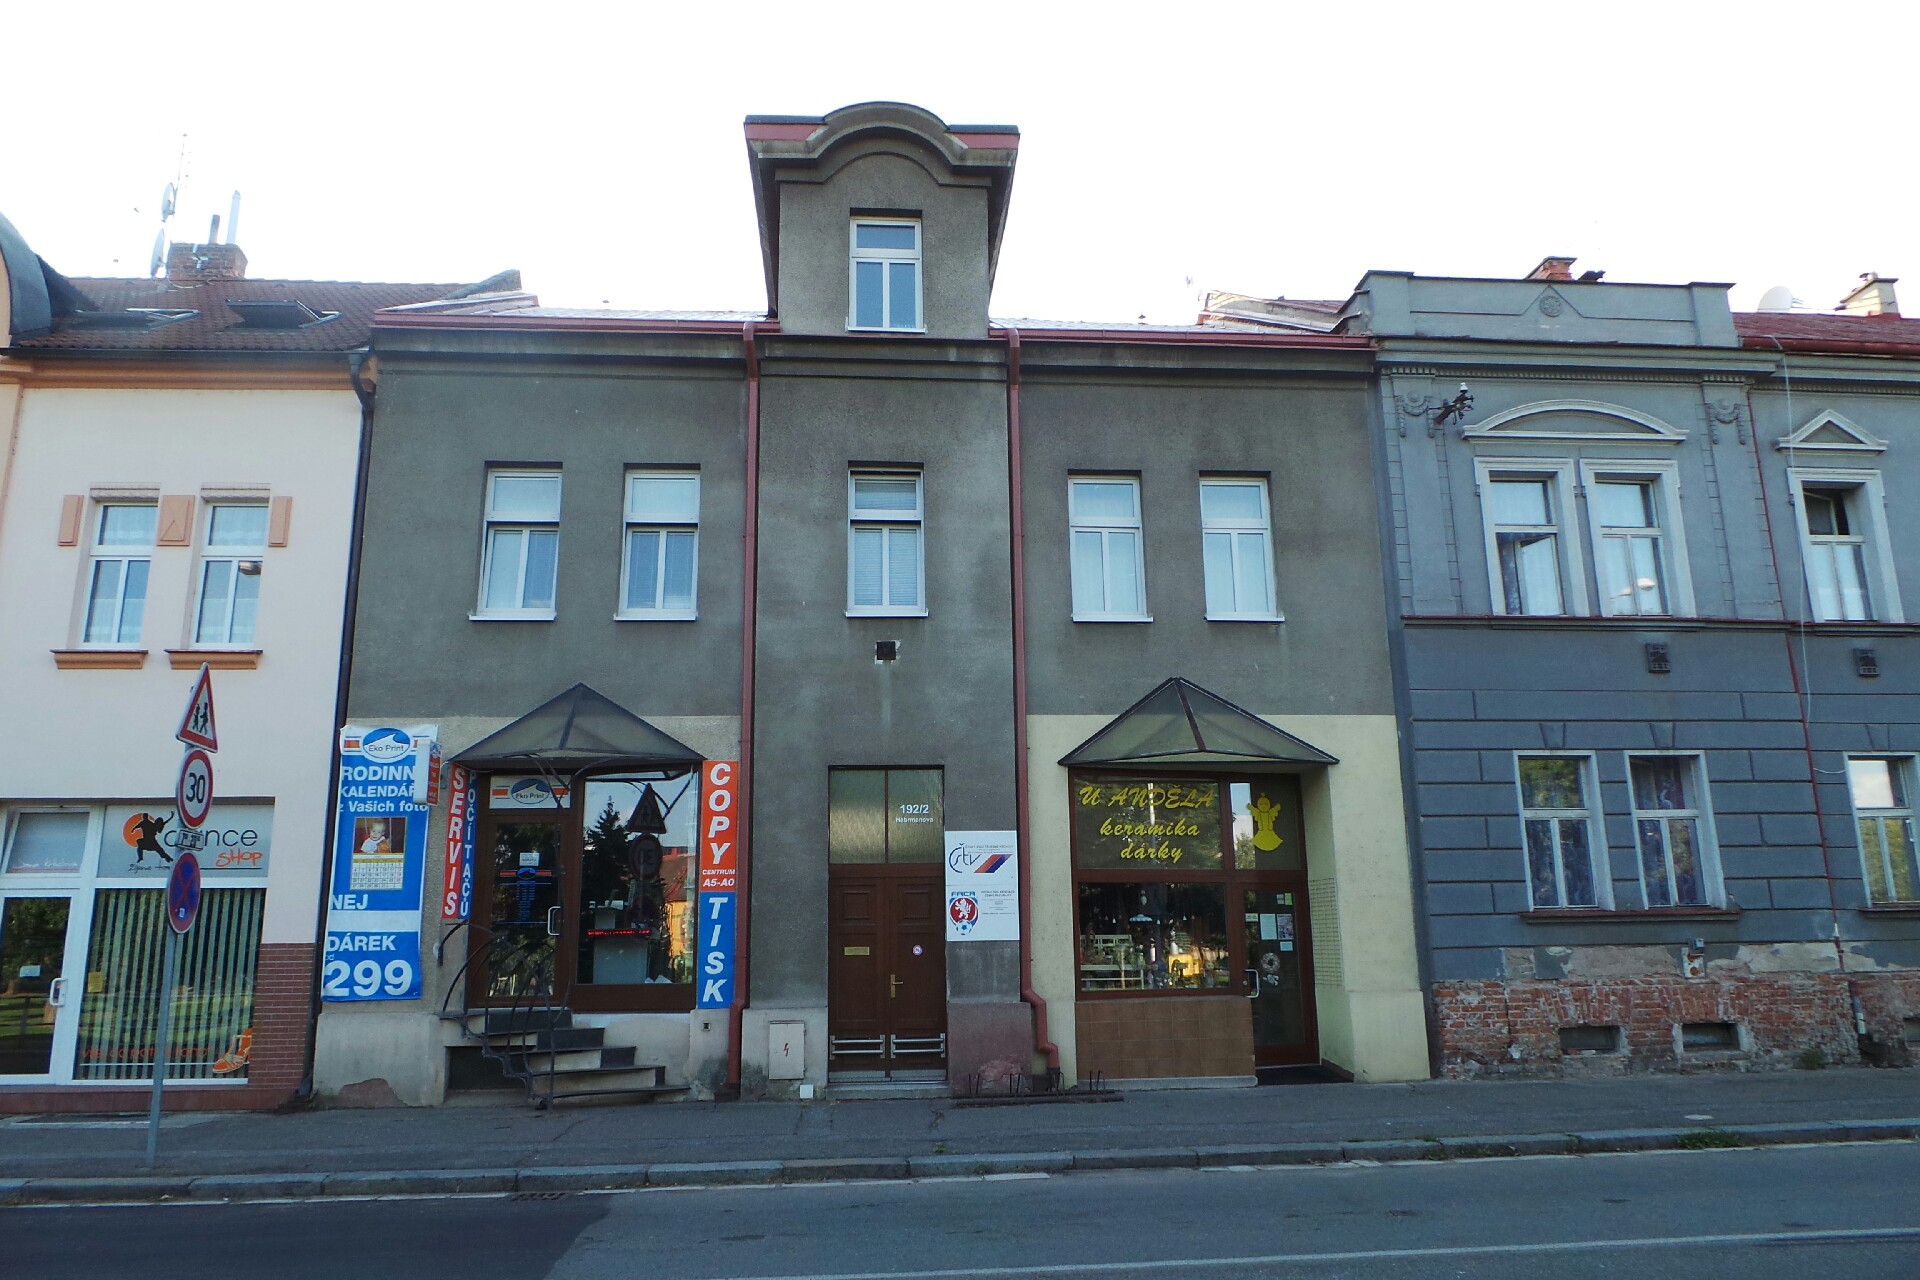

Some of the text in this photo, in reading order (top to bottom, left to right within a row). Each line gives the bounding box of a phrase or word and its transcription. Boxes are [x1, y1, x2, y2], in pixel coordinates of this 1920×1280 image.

[342, 765, 415, 781] RODINN
[186, 773, 206, 804] 30
[1080, 785, 1215, 809] U ANDĚLA
[349, 801, 395, 812] Vašich
[399, 801, 429, 812] foto
[708, 763, 731, 865] COPY
[900, 804, 929, 814] 192/2
[1100, 818, 1199, 836] keramika
[444, 767, 465, 916] SERVIS
[1120, 841, 1183, 864] dárky
[330, 894, 369, 910] NEJ
[326, 933, 397, 952] DÁREK
[702, 897, 728, 1002] TISK
[323, 959, 413, 997] 299
